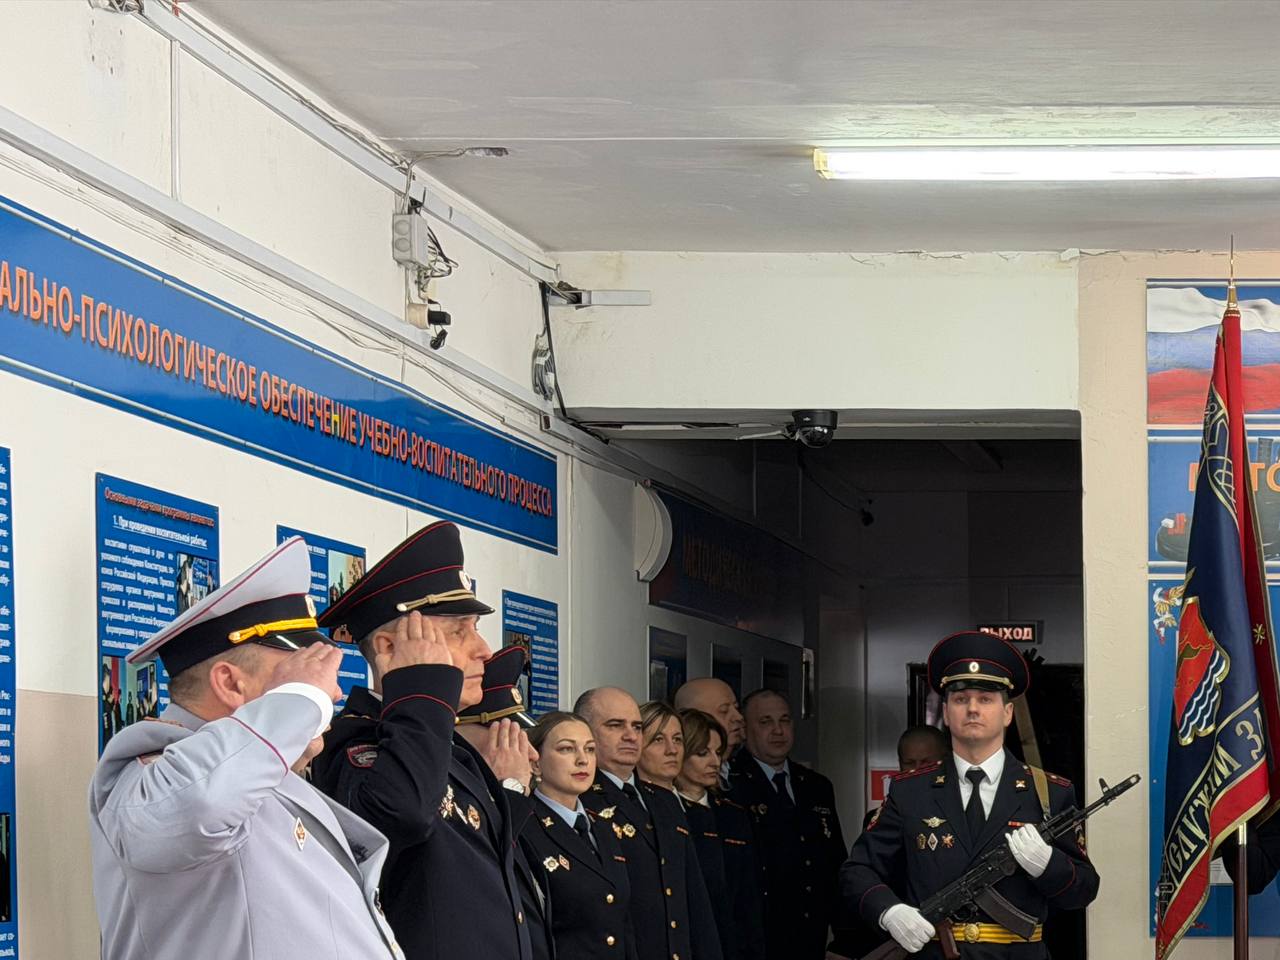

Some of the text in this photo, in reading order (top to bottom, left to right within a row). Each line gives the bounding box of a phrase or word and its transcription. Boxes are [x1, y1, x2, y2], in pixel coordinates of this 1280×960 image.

[260, 371, 357, 444] ОБЕСПЕЧЕНИЕ
[359, 410, 508, 499] УЧЕБНО-ВОСПИТАТЕЛЬНОГО
[508, 472, 553, 518] ПРОЦЕССА
